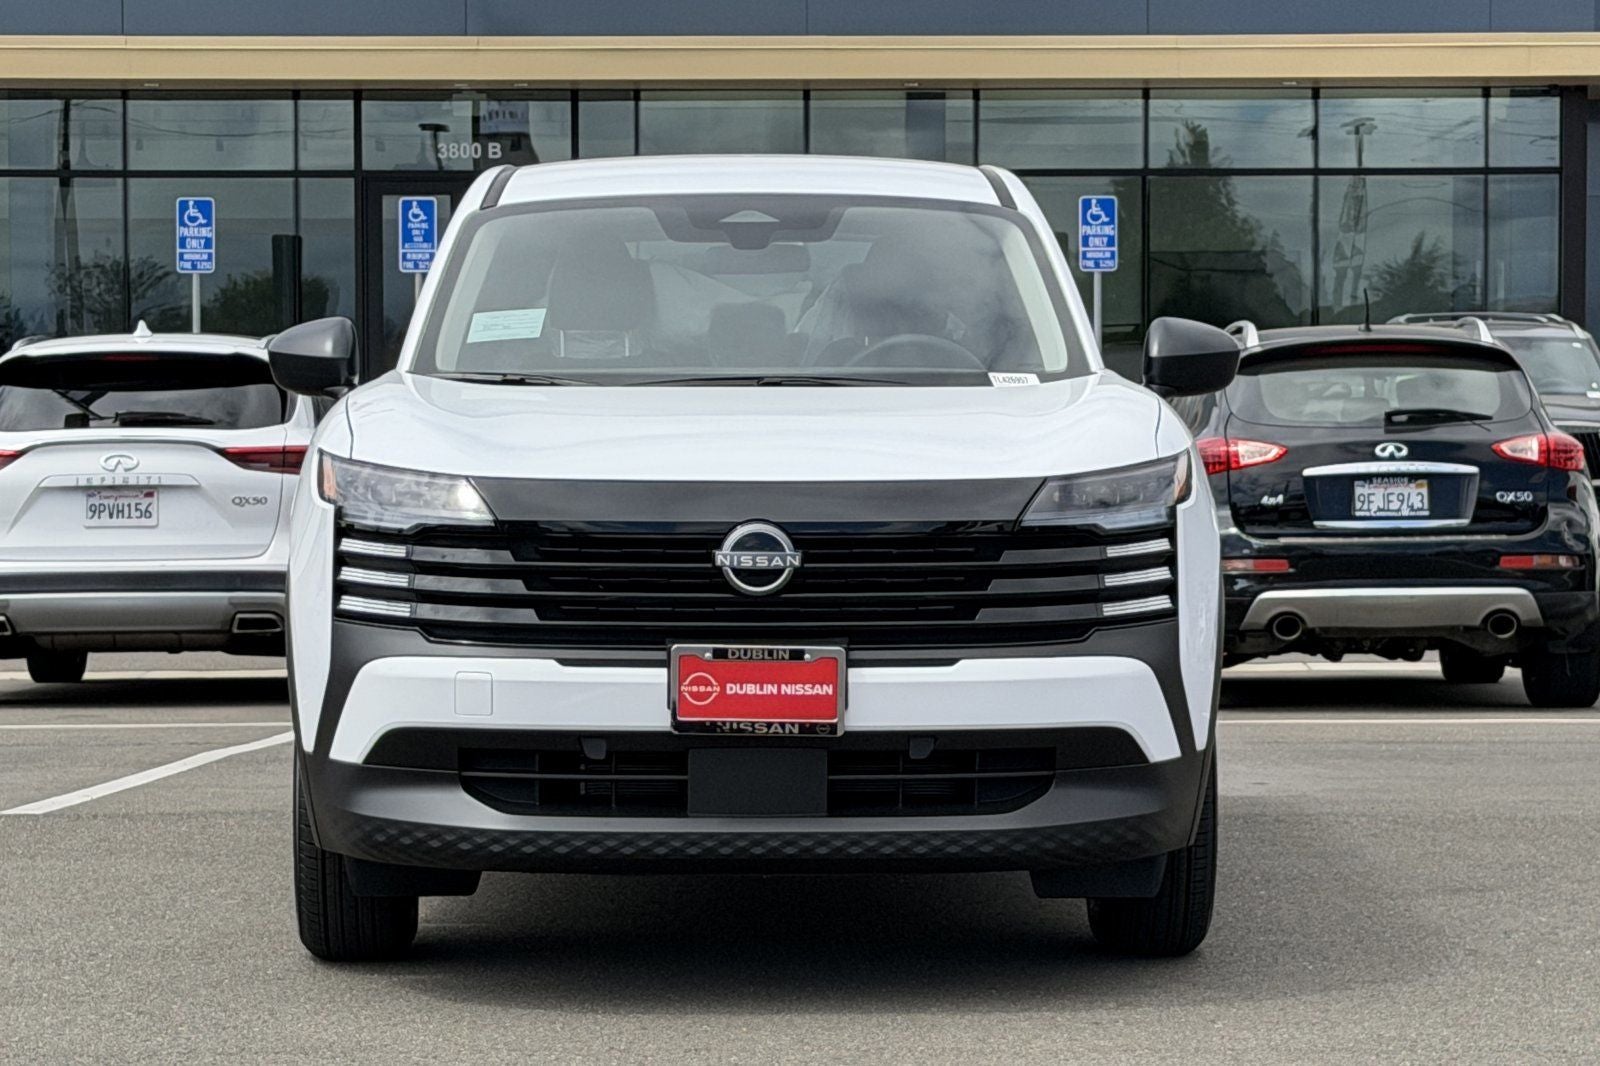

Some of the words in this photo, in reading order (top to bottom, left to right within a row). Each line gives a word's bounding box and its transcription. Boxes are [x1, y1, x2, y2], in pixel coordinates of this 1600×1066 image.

[437, 142, 482, 159] 3800
[488, 142, 503, 159] B
[180, 226, 213, 238] PARKING
[1082, 225, 1115, 236] PARKING
[185, 237, 206, 249] ONLY
[1088, 236, 1108, 248] ONLY
[232, 496, 268, 508] QX50
[1495, 491, 1533, 504] QX50
[88, 502, 153, 520] 9PVH156
[717, 555, 800, 567] NISSAN
[727, 649, 790, 660] DUBLIN
[726, 683, 778, 695] DUBLIN
[781, 684, 833, 696] NISSAN
